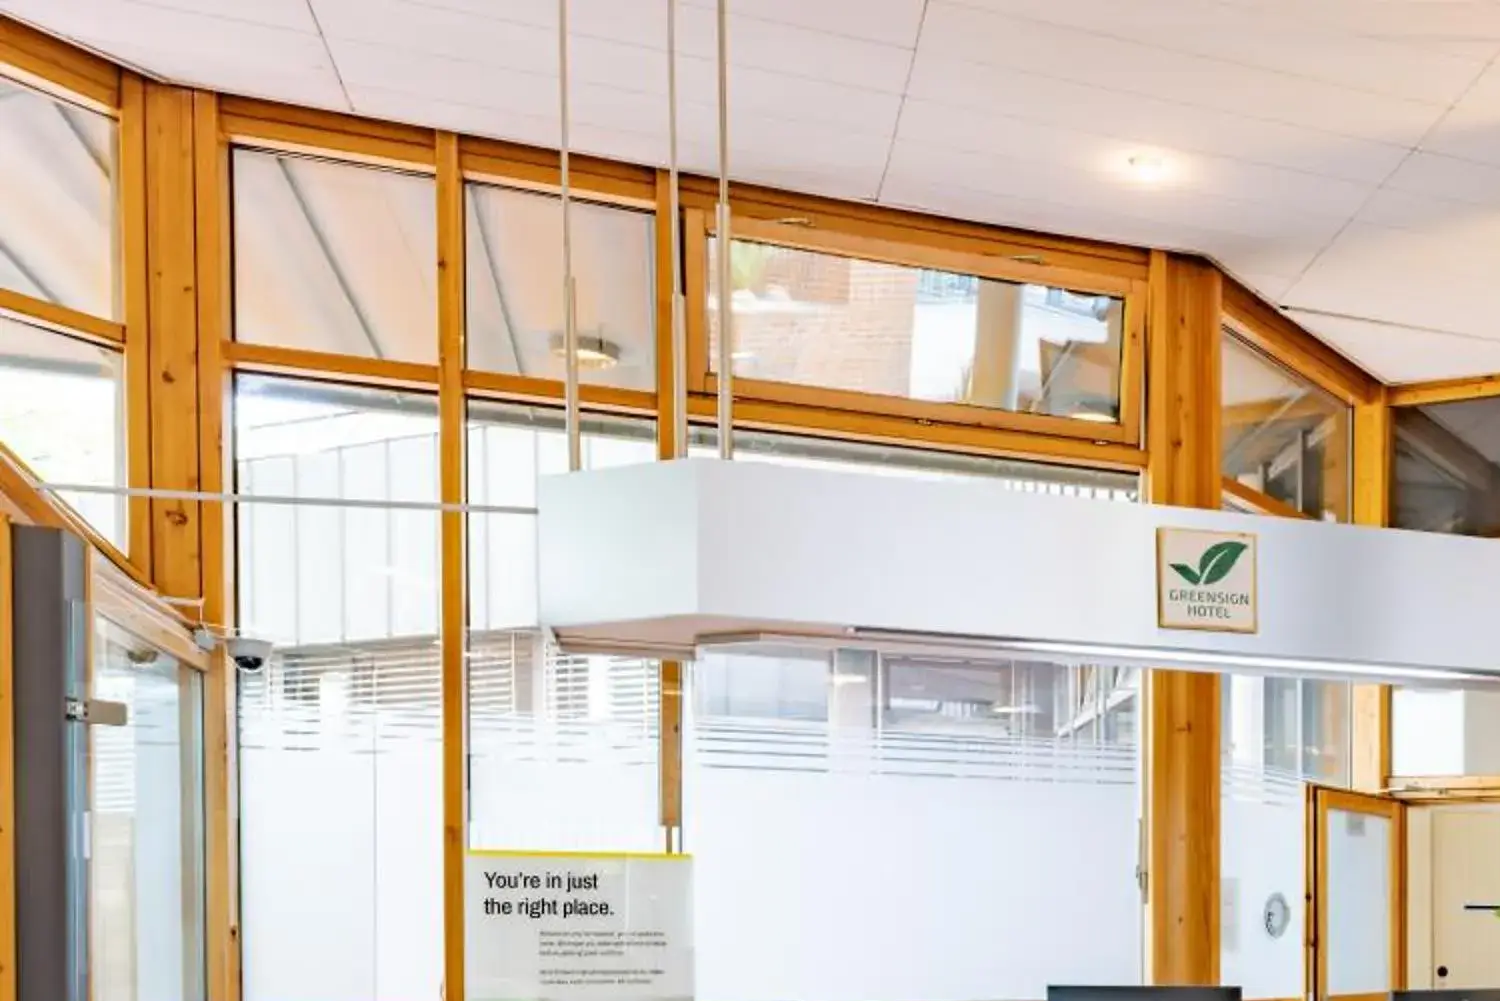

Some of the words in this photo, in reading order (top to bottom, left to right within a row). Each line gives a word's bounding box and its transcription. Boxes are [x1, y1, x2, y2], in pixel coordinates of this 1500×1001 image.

[1168, 588, 1250, 605] GREENSIGN
[1187, 604, 1231, 619] HOTEL
[484, 871, 541, 889] You're
[546, 871, 562, 889] in
[566, 872, 599, 893] just
[484, 898, 512, 915] the
[518, 898, 557, 918] right
[563, 899, 614, 918] place.
